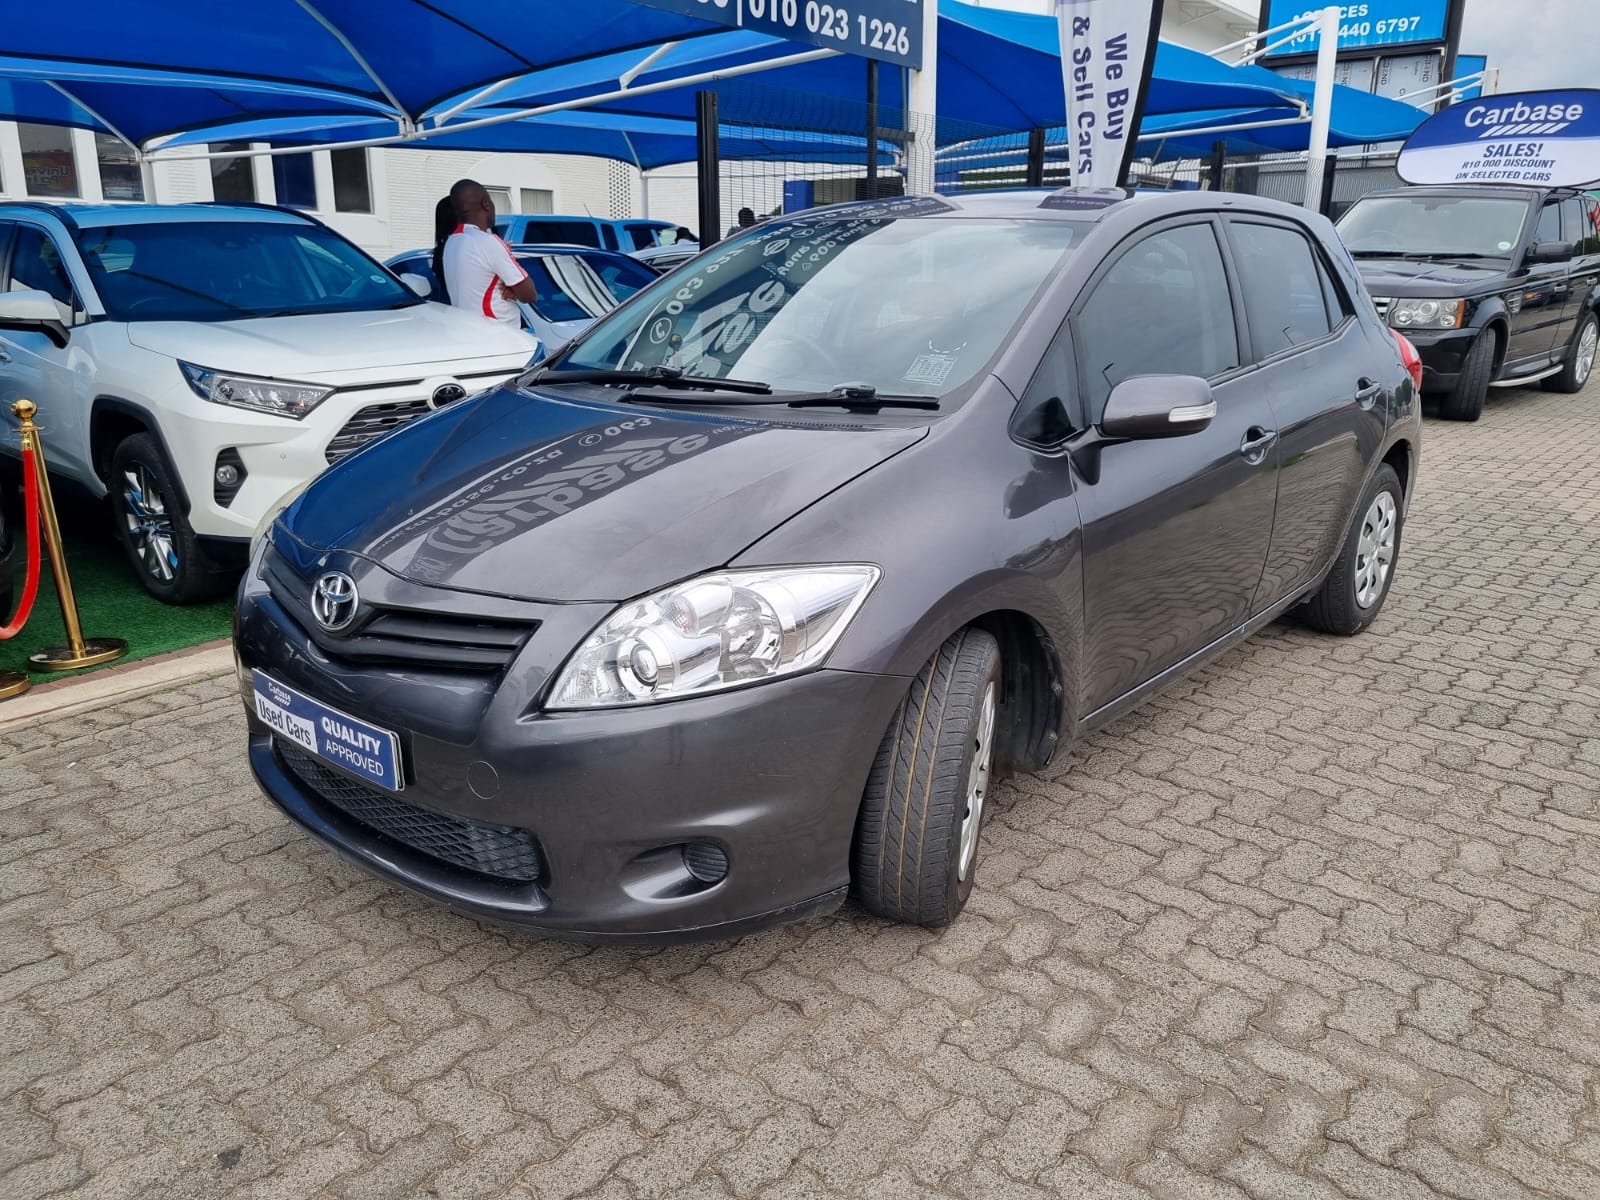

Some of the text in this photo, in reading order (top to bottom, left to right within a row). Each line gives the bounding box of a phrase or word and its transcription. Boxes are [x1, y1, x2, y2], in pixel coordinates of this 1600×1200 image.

[806, 2, 849, 40] 023
[858, 15, 910, 56] 1226
[1376, 16, 1421, 34] 6797
[1073, 17, 1096, 175] & Sell Cars
[1103, 33, 1129, 140] We Buy
[1464, 101, 1584, 128] Carbase
[1461, 159, 1556, 169] R10 000 DISCOUNT
[1482, 143, 1544, 158] SALES!
[1455, 171, 1553, 181] ON SELECTED CARS
[268, 682, 292, 702] Carbase
[258, 698, 312, 746] Used Cars
[321, 716, 381, 756] QUALITY
[325, 739, 384, 777] APPROVED
